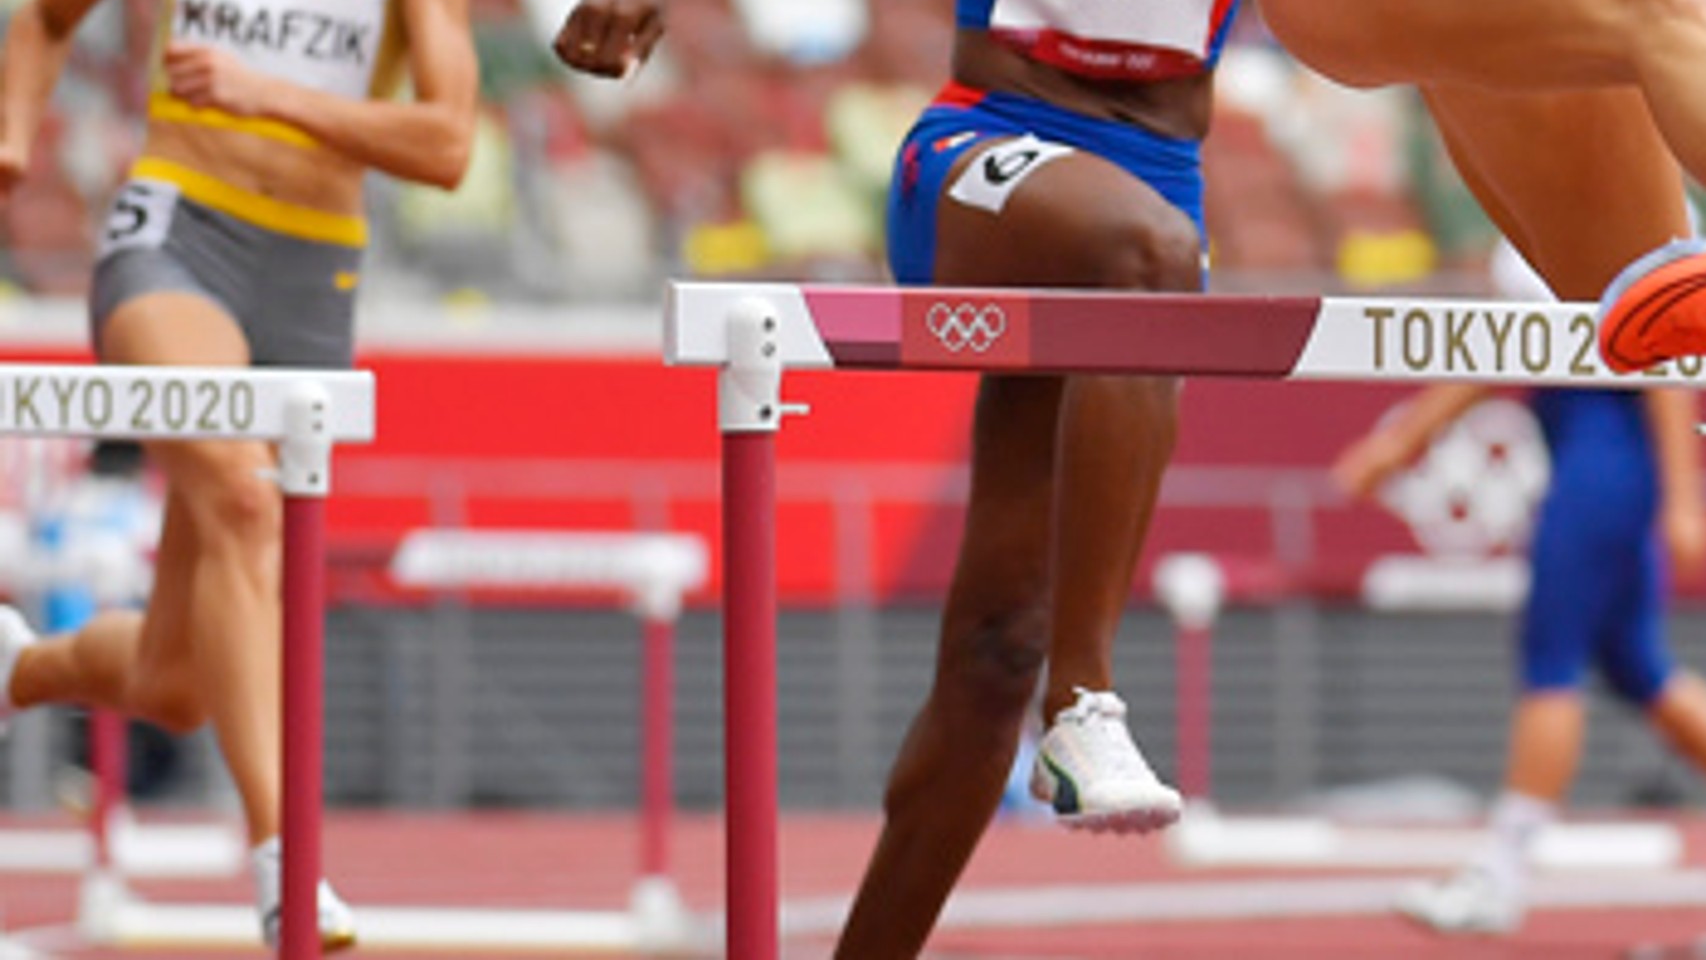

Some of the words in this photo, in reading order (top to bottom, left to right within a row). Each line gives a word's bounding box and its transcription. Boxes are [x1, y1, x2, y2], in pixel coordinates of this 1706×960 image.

[107, 185, 151, 240] 5
[1364, 307, 1553, 374] TOKYO
[0, 377, 113, 430] KYO
[130, 378, 255, 431] 2020
